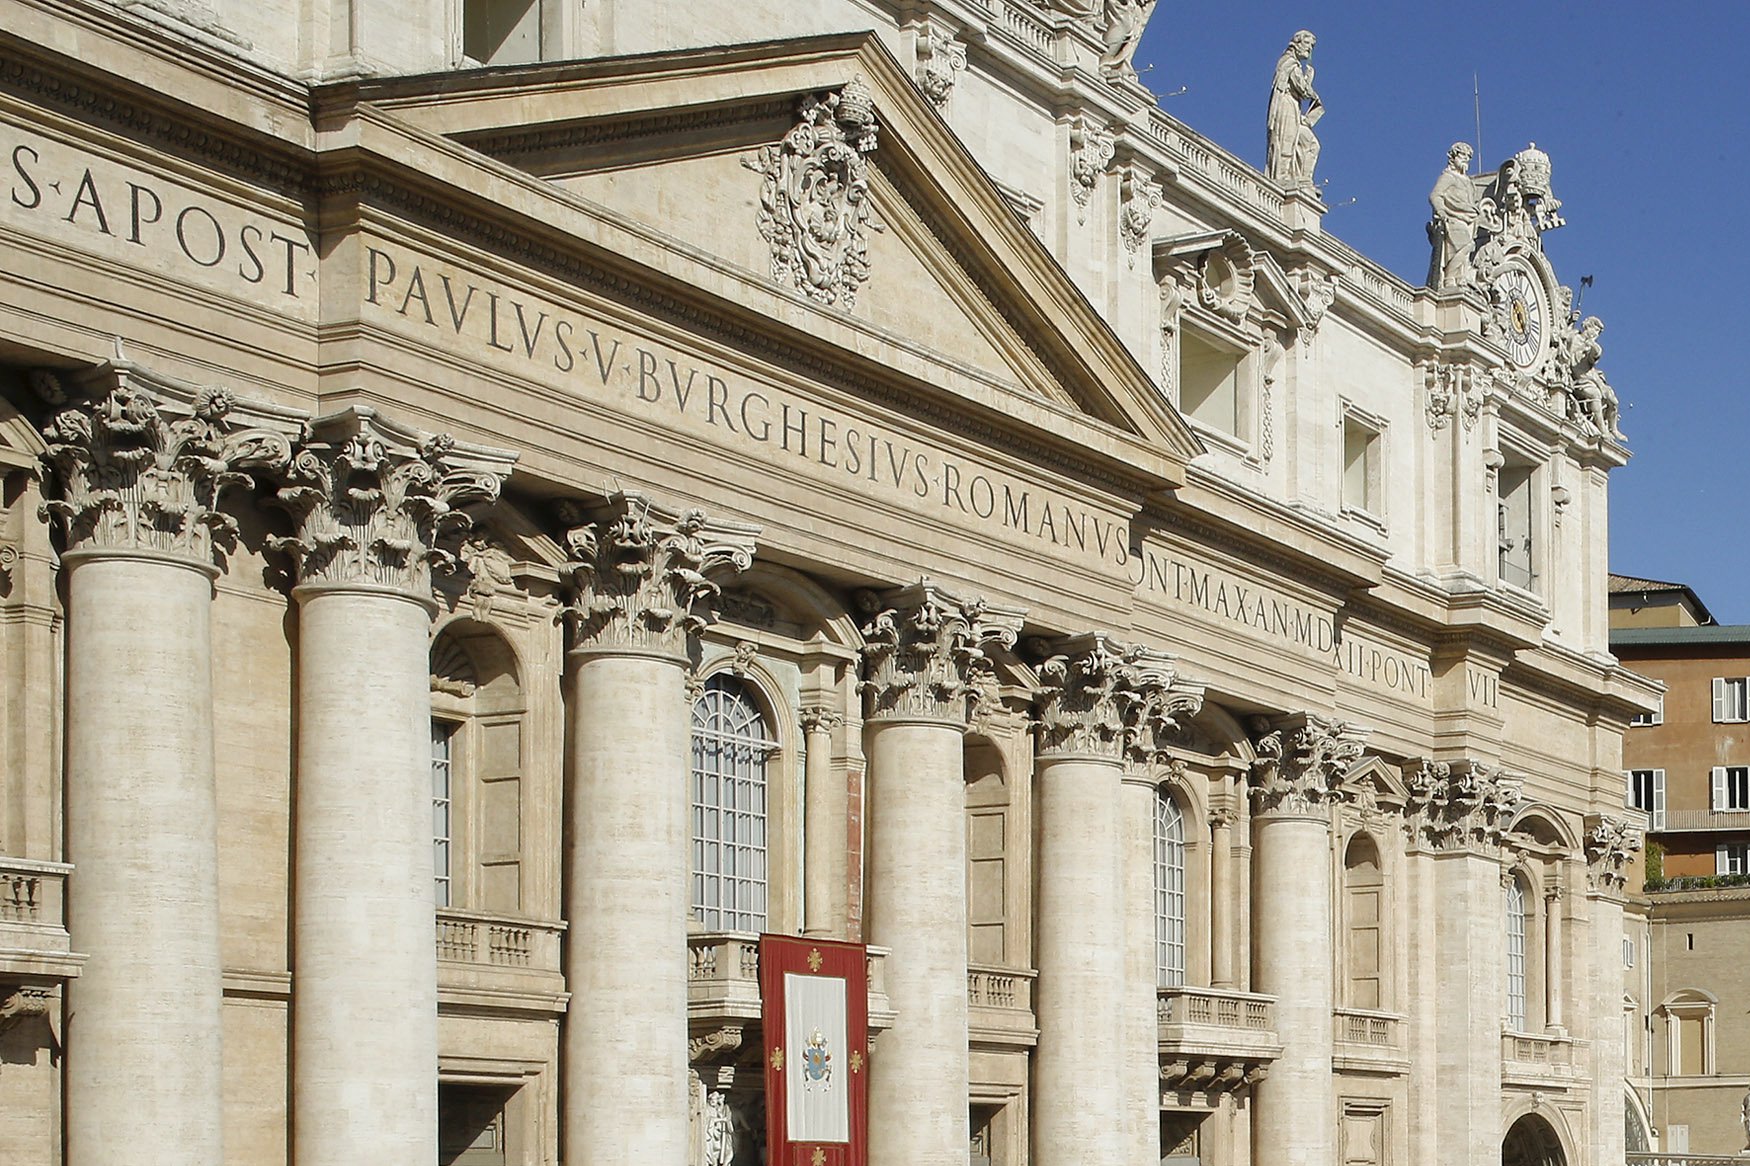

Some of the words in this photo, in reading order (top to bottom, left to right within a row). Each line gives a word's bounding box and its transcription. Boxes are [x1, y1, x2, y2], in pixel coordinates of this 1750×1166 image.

[61, 168, 310, 298] APOST
[364, 246, 575, 372] PAVLVS
[586, 329, 622, 386] V
[636, 348, 927, 497] BVRGHESIVS
[942, 462, 1127, 566] ROMANVS
[1189, 567, 1249, 624] MAX
[1253, 595, 1288, 638] AN
[1370, 649, 1429, 699] PONT
[1467, 669, 1498, 708] VII
